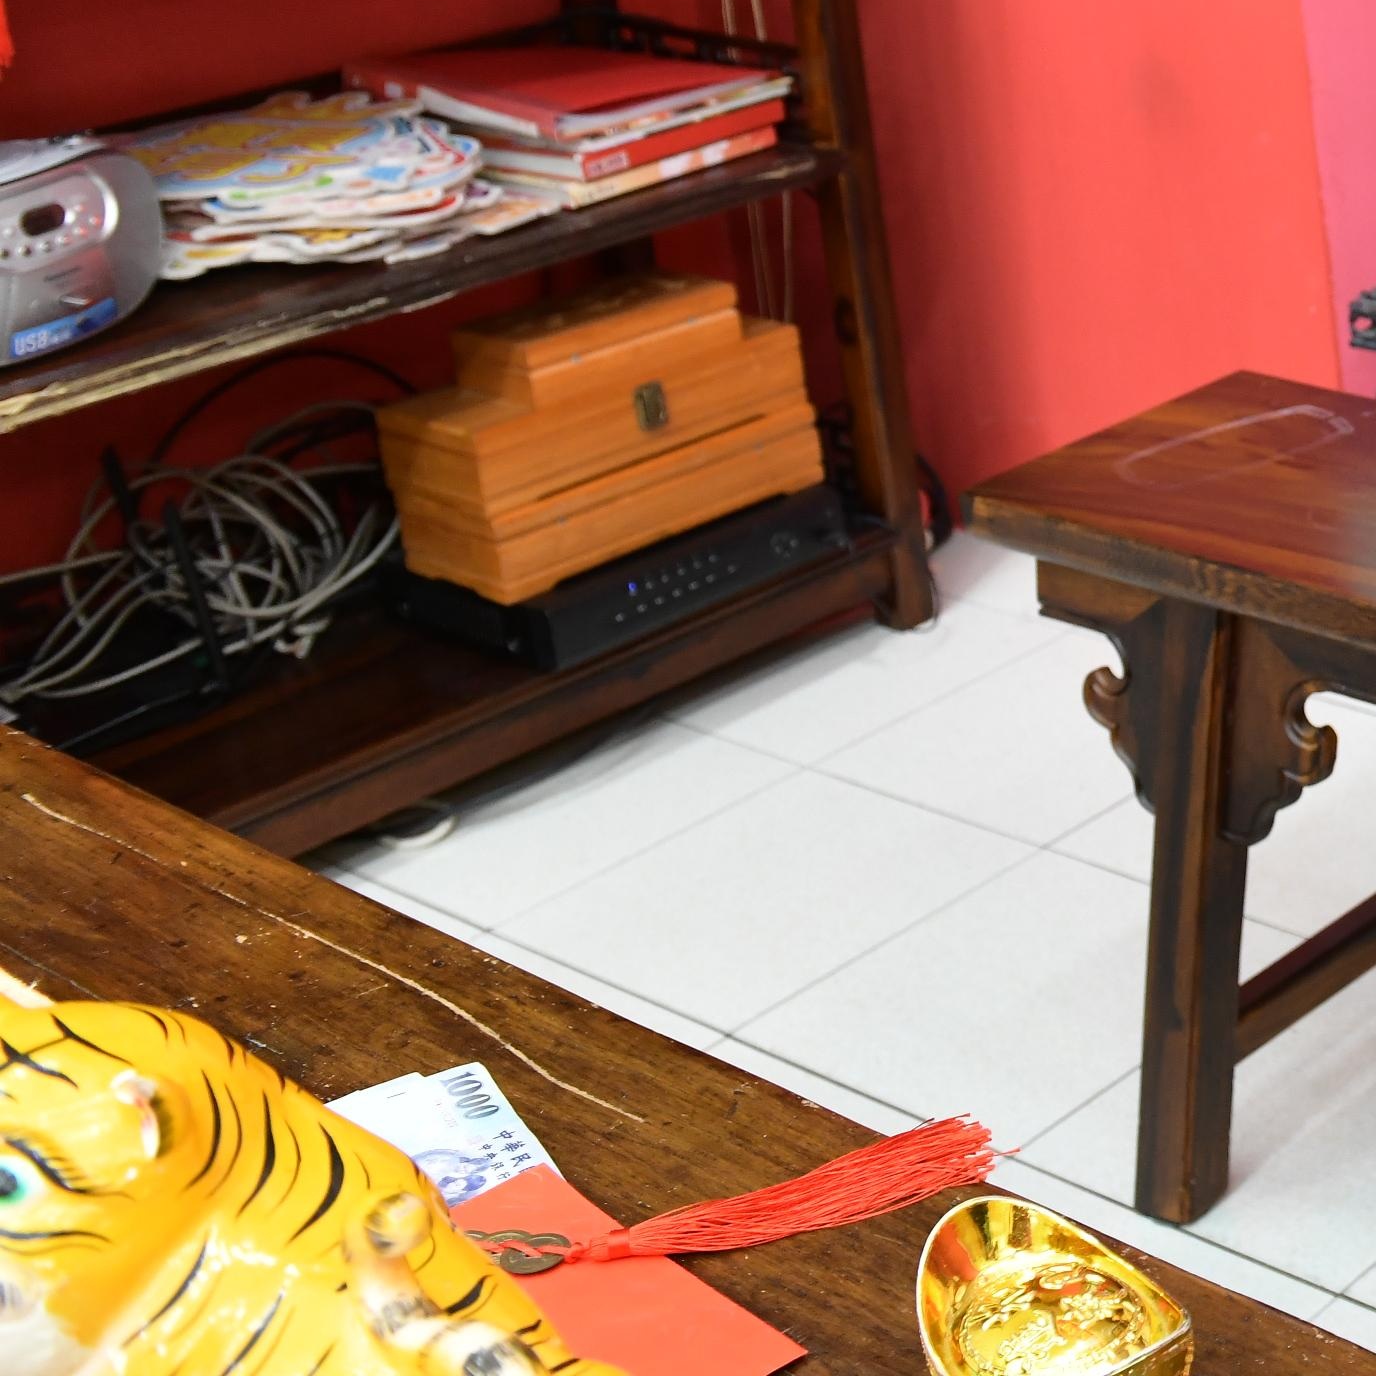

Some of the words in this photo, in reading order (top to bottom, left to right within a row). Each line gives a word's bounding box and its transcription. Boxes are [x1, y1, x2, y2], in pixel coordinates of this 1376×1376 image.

[440, 1072, 500, 1120] 1000
[493, 1130, 536, 1174] 中華民
